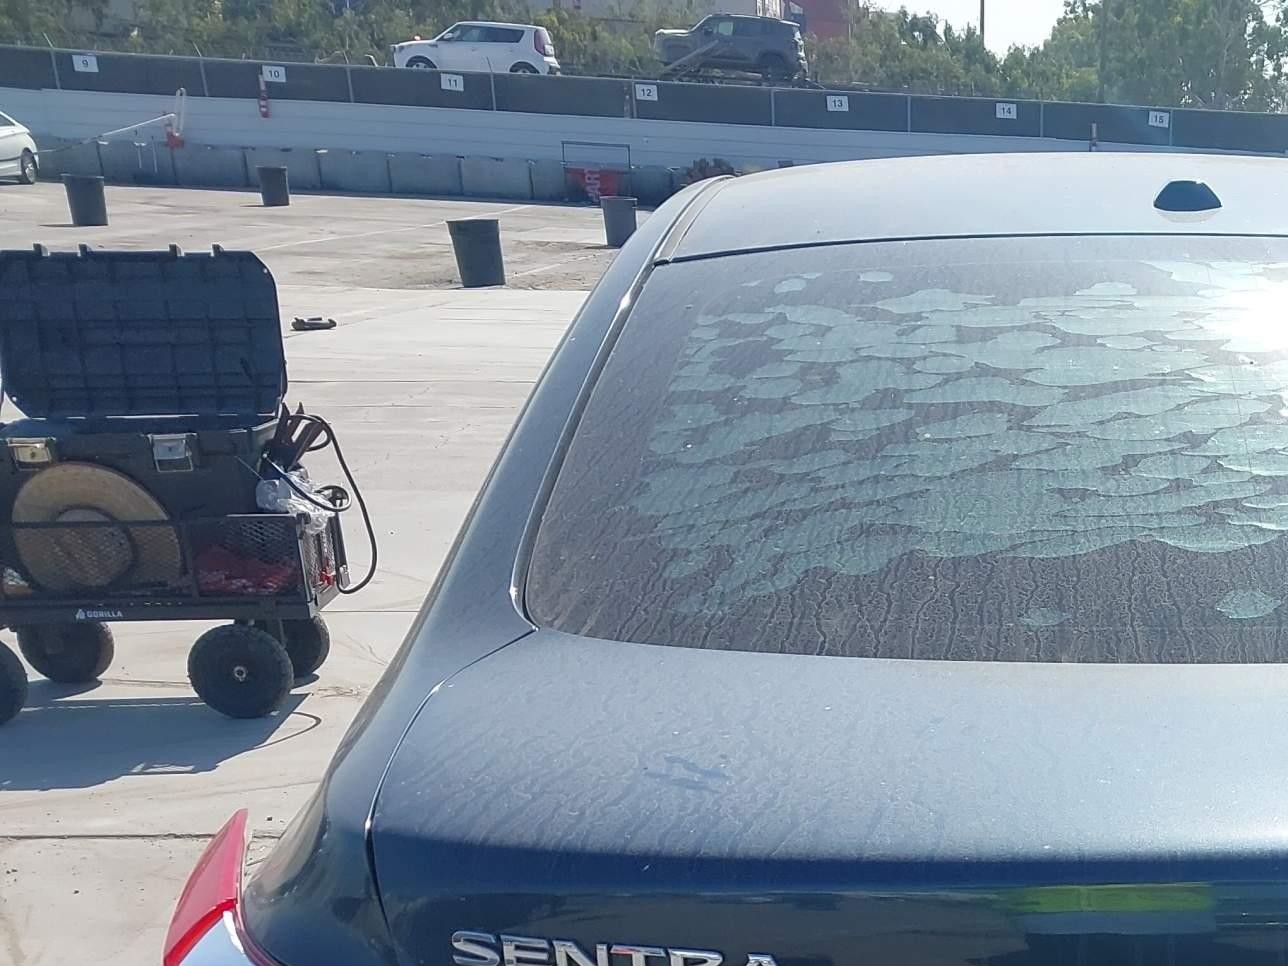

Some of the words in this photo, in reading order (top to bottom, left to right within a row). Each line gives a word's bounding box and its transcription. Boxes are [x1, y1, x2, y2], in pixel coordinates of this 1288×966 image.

[269, 69, 280, 78] 10
[448, 79, 458, 88] 11
[641, 88, 652, 97] 12
[832, 99, 843, 108] 13
[1002, 106, 1012, 116] 14
[1154, 115, 1164, 124] 15
[87, 610, 123, 618] GORILLA
